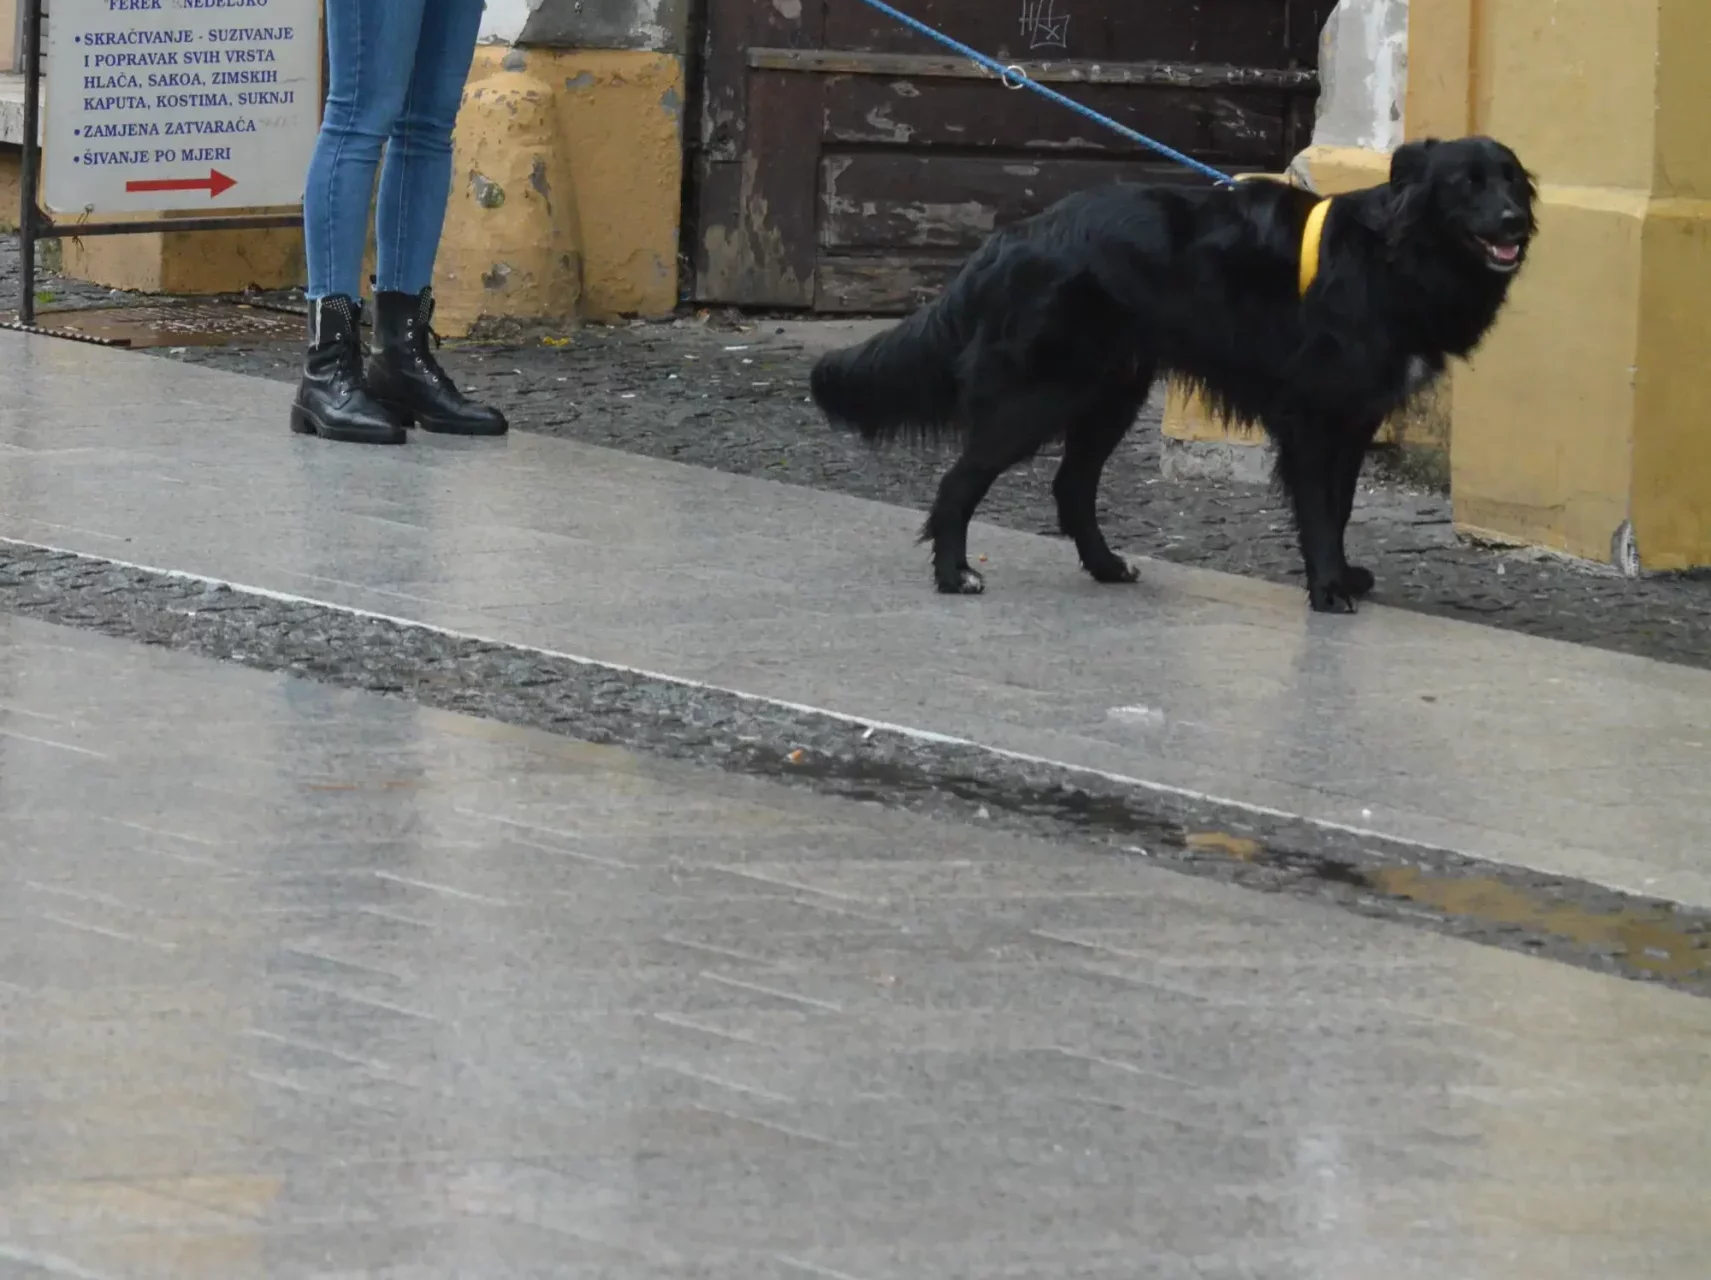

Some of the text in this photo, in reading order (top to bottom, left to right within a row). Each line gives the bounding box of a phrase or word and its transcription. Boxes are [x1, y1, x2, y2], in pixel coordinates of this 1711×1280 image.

[84, 28, 194, 46] SKRAČIVANJE
[95, 52, 179, 68] POPRAVAK
[183, 50, 221, 65] SVIH
[225, 48, 276, 63] VRSTA
[84, 70, 278, 89] HLAČA, SAKOA, ZIMSKIH
[83, 91, 295, 111] KAPUTA, KOSTIMA, SUKNJI
[83, 116, 257, 138] ZAMJENA ZATVARAČA
[83, 147, 232, 166] ŠIVANJE PO MJERI
